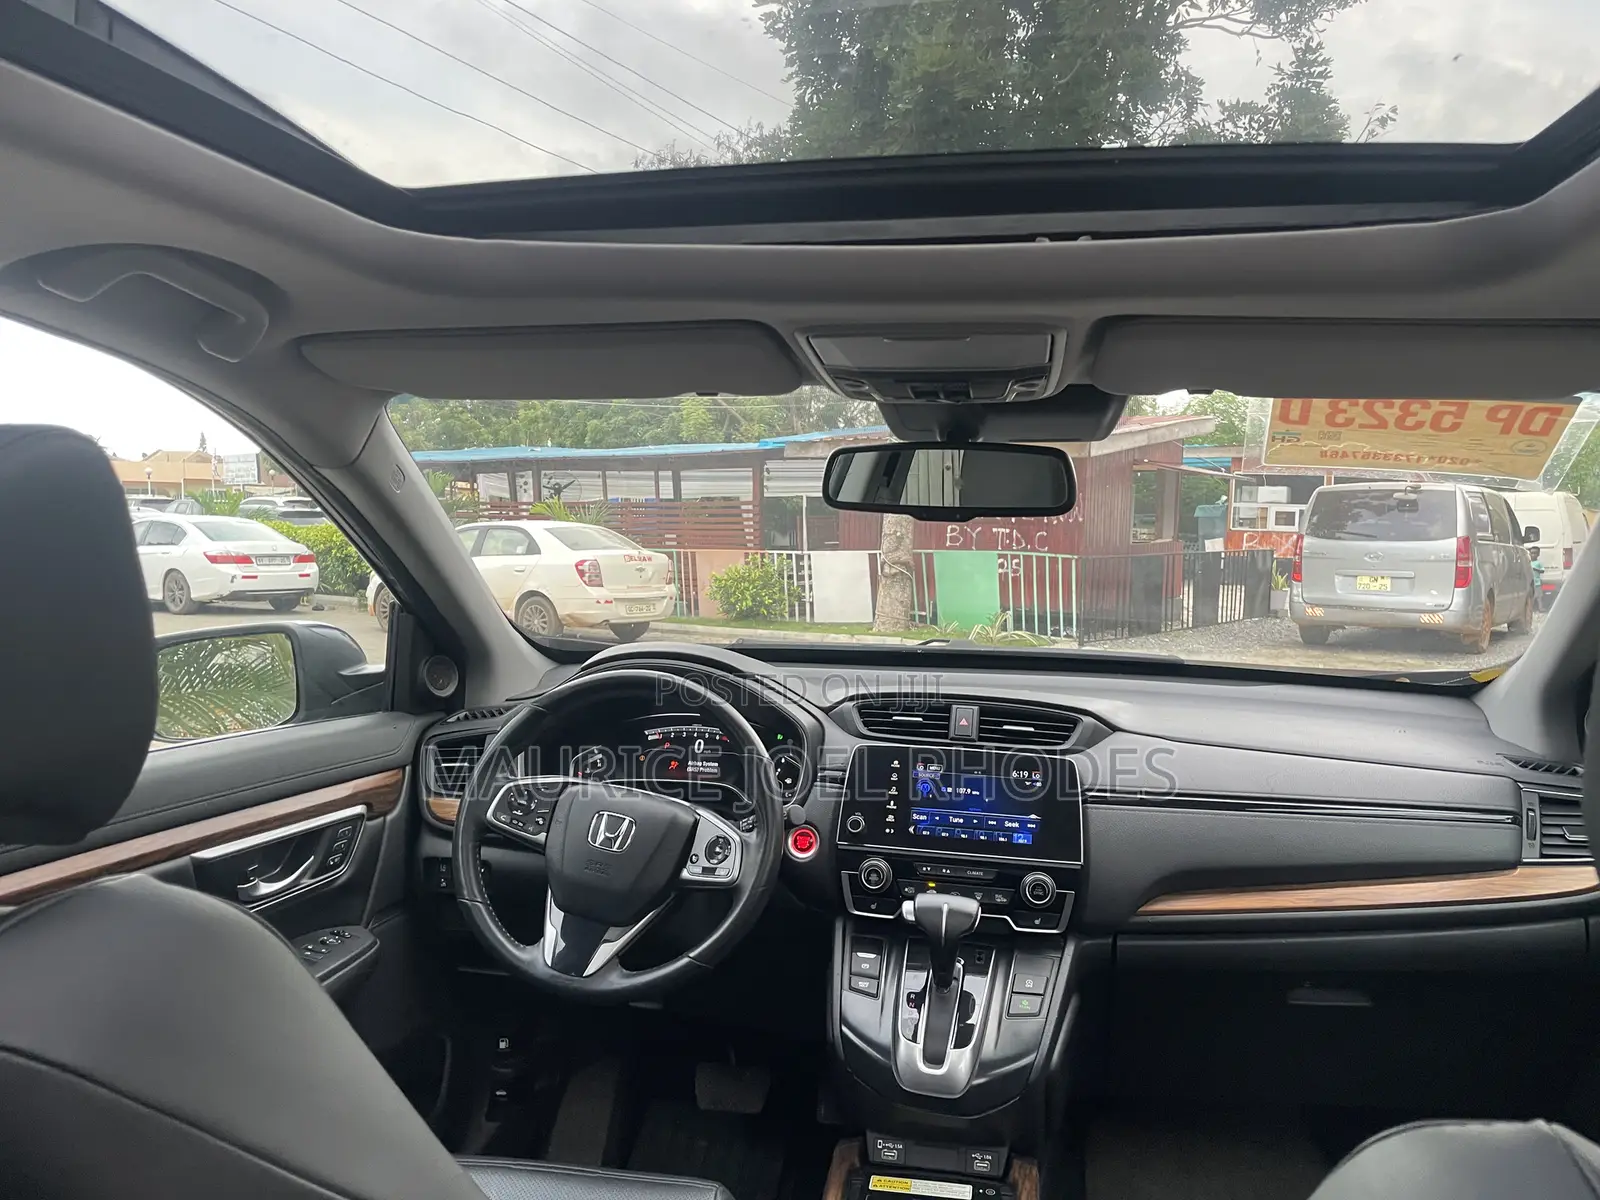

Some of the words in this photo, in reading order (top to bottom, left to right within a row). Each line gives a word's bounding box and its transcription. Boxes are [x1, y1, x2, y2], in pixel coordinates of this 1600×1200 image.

[946, 525, 982, 550] BY
[694, 738, 705, 754] 0
[1012, 770, 1029, 779] 6:19
[956, 787, 972, 795] 107.9
[912, 813, 927, 821] Scan
[949, 816, 964, 824] Tune
[1004, 820, 1020, 828] Seek
